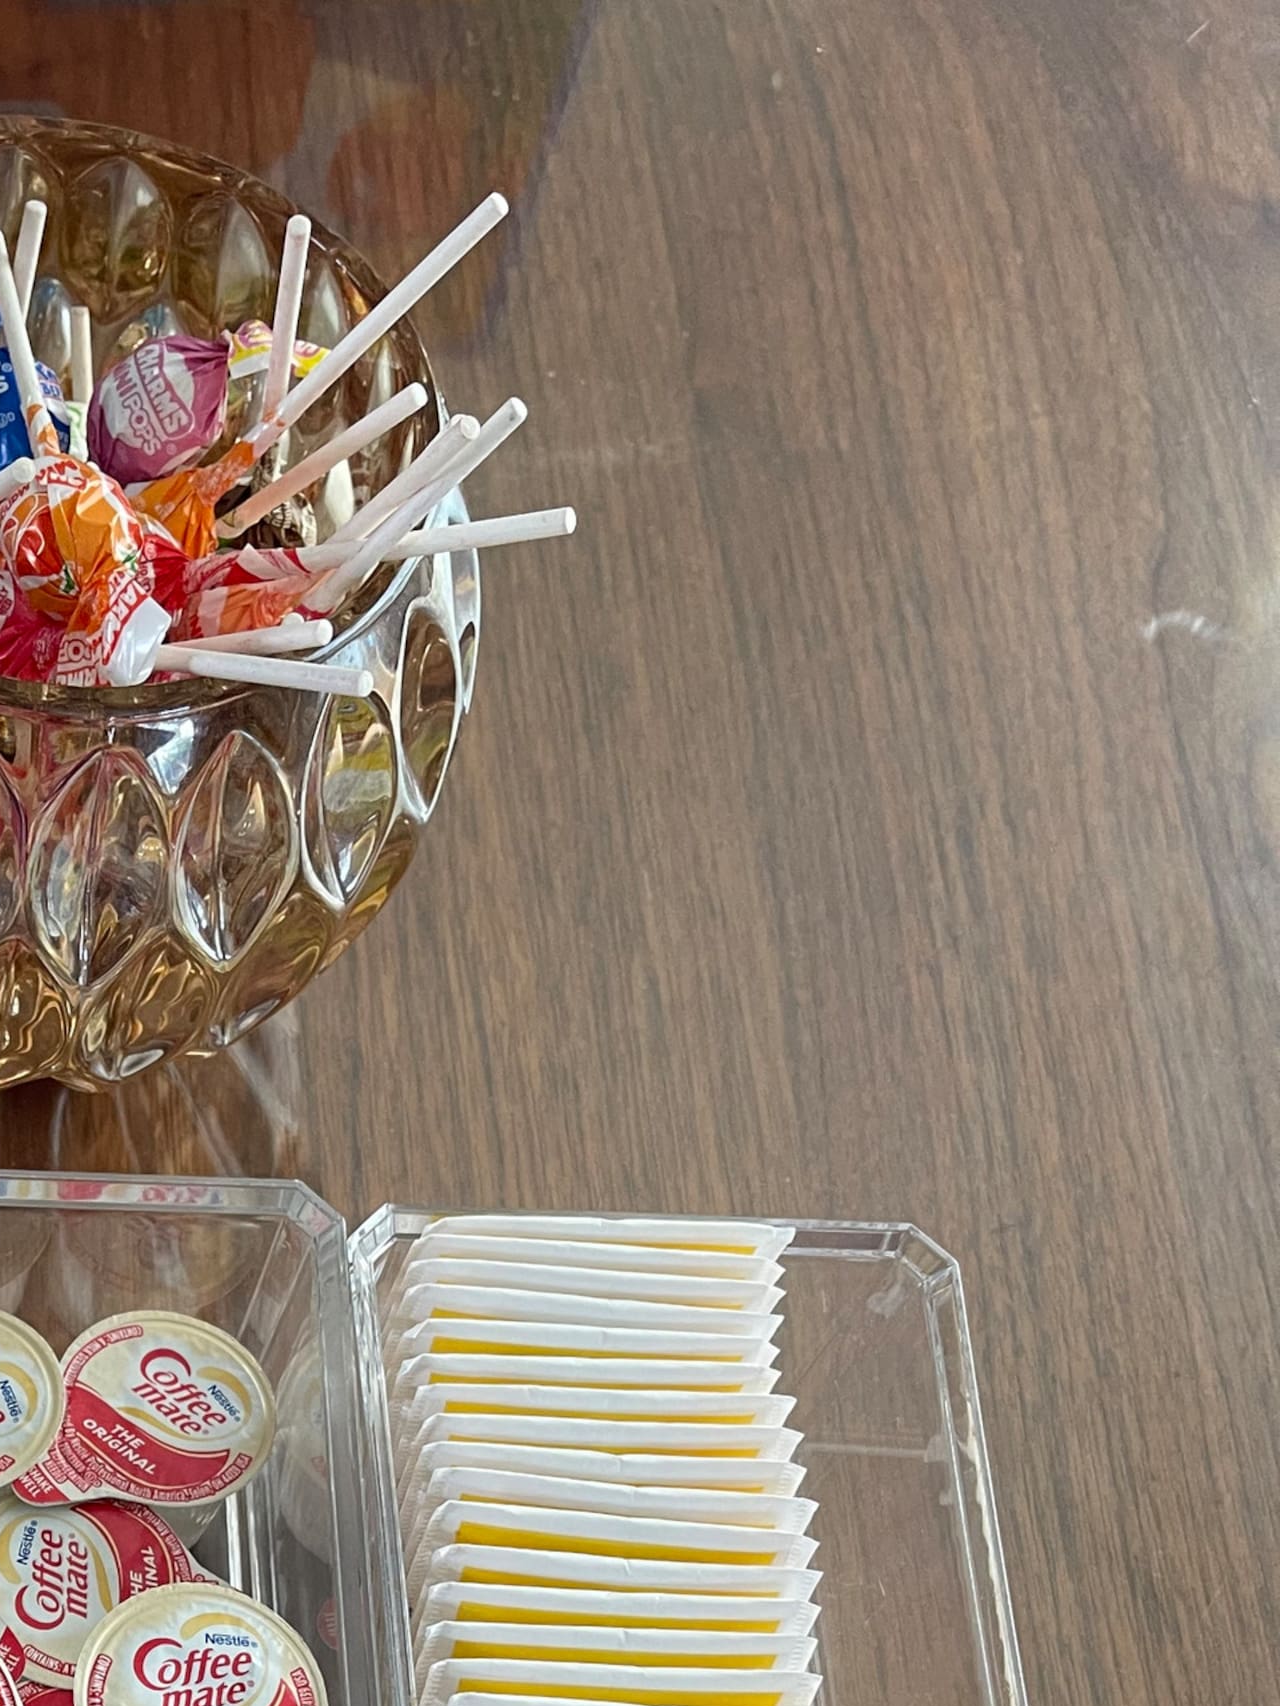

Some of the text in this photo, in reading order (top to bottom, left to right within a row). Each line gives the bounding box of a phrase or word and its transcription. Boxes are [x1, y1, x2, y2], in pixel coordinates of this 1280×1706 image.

[122, 395, 161, 455] POPS
[132, 1383, 201, 1435] mate
[140, 1348, 226, 1426] Coffee
[83, 1419, 155, 1475] ORIGINAL
[111, 1424, 145, 1449] THE
[15, 1529, 65, 1630] Coffee
[67, 1541, 88, 1619] mate
[133, 1638, 251, 1691] Coffee
[205, 1633, 250, 1647] Nestlé
